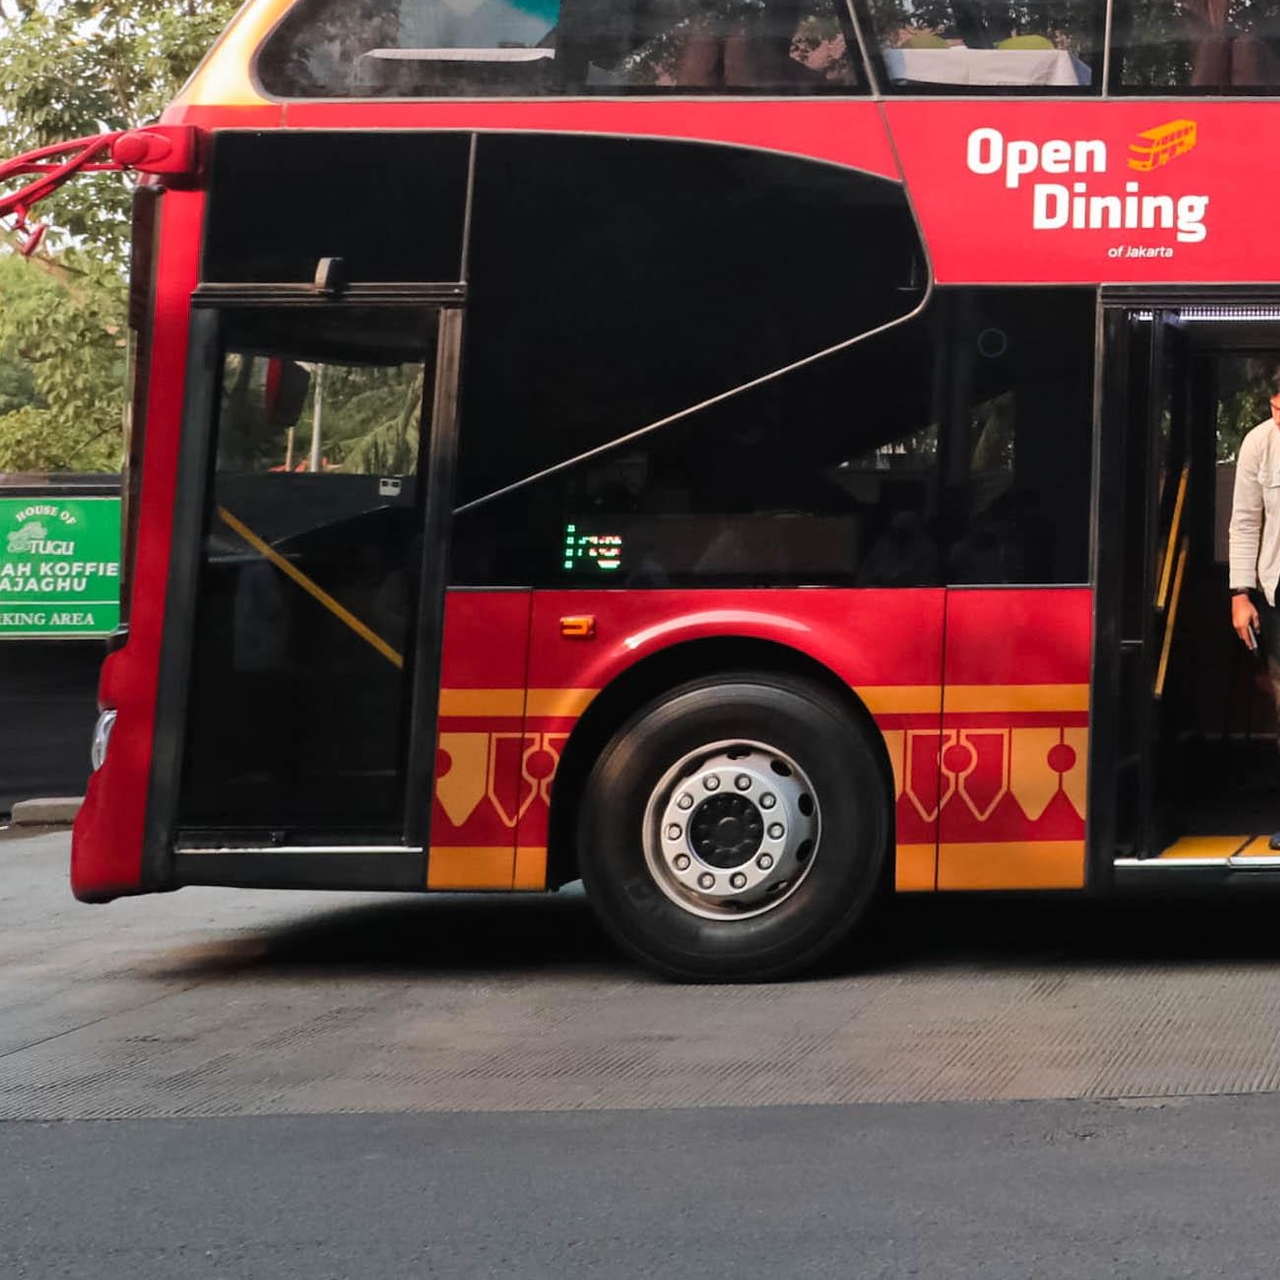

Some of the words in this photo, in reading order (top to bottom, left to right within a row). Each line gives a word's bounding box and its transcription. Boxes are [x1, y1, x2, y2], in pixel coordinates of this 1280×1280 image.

[966, 127, 1107, 189] Open
[1033, 181, 1210, 243] Dining
[1108, 245, 1123, 257] of
[1125, 245, 1174, 258] Jakarta
[16, 505, 58, 522] HOUSE
[60, 510, 77, 524] OF
[29, 540, 75, 555] TUGU
[40, 562, 119, 577] KOFFIE
[0, 577, 87, 592] AJAGHU
[0, 612, 47, 626] KING
[49, 612, 95, 626] AREA
